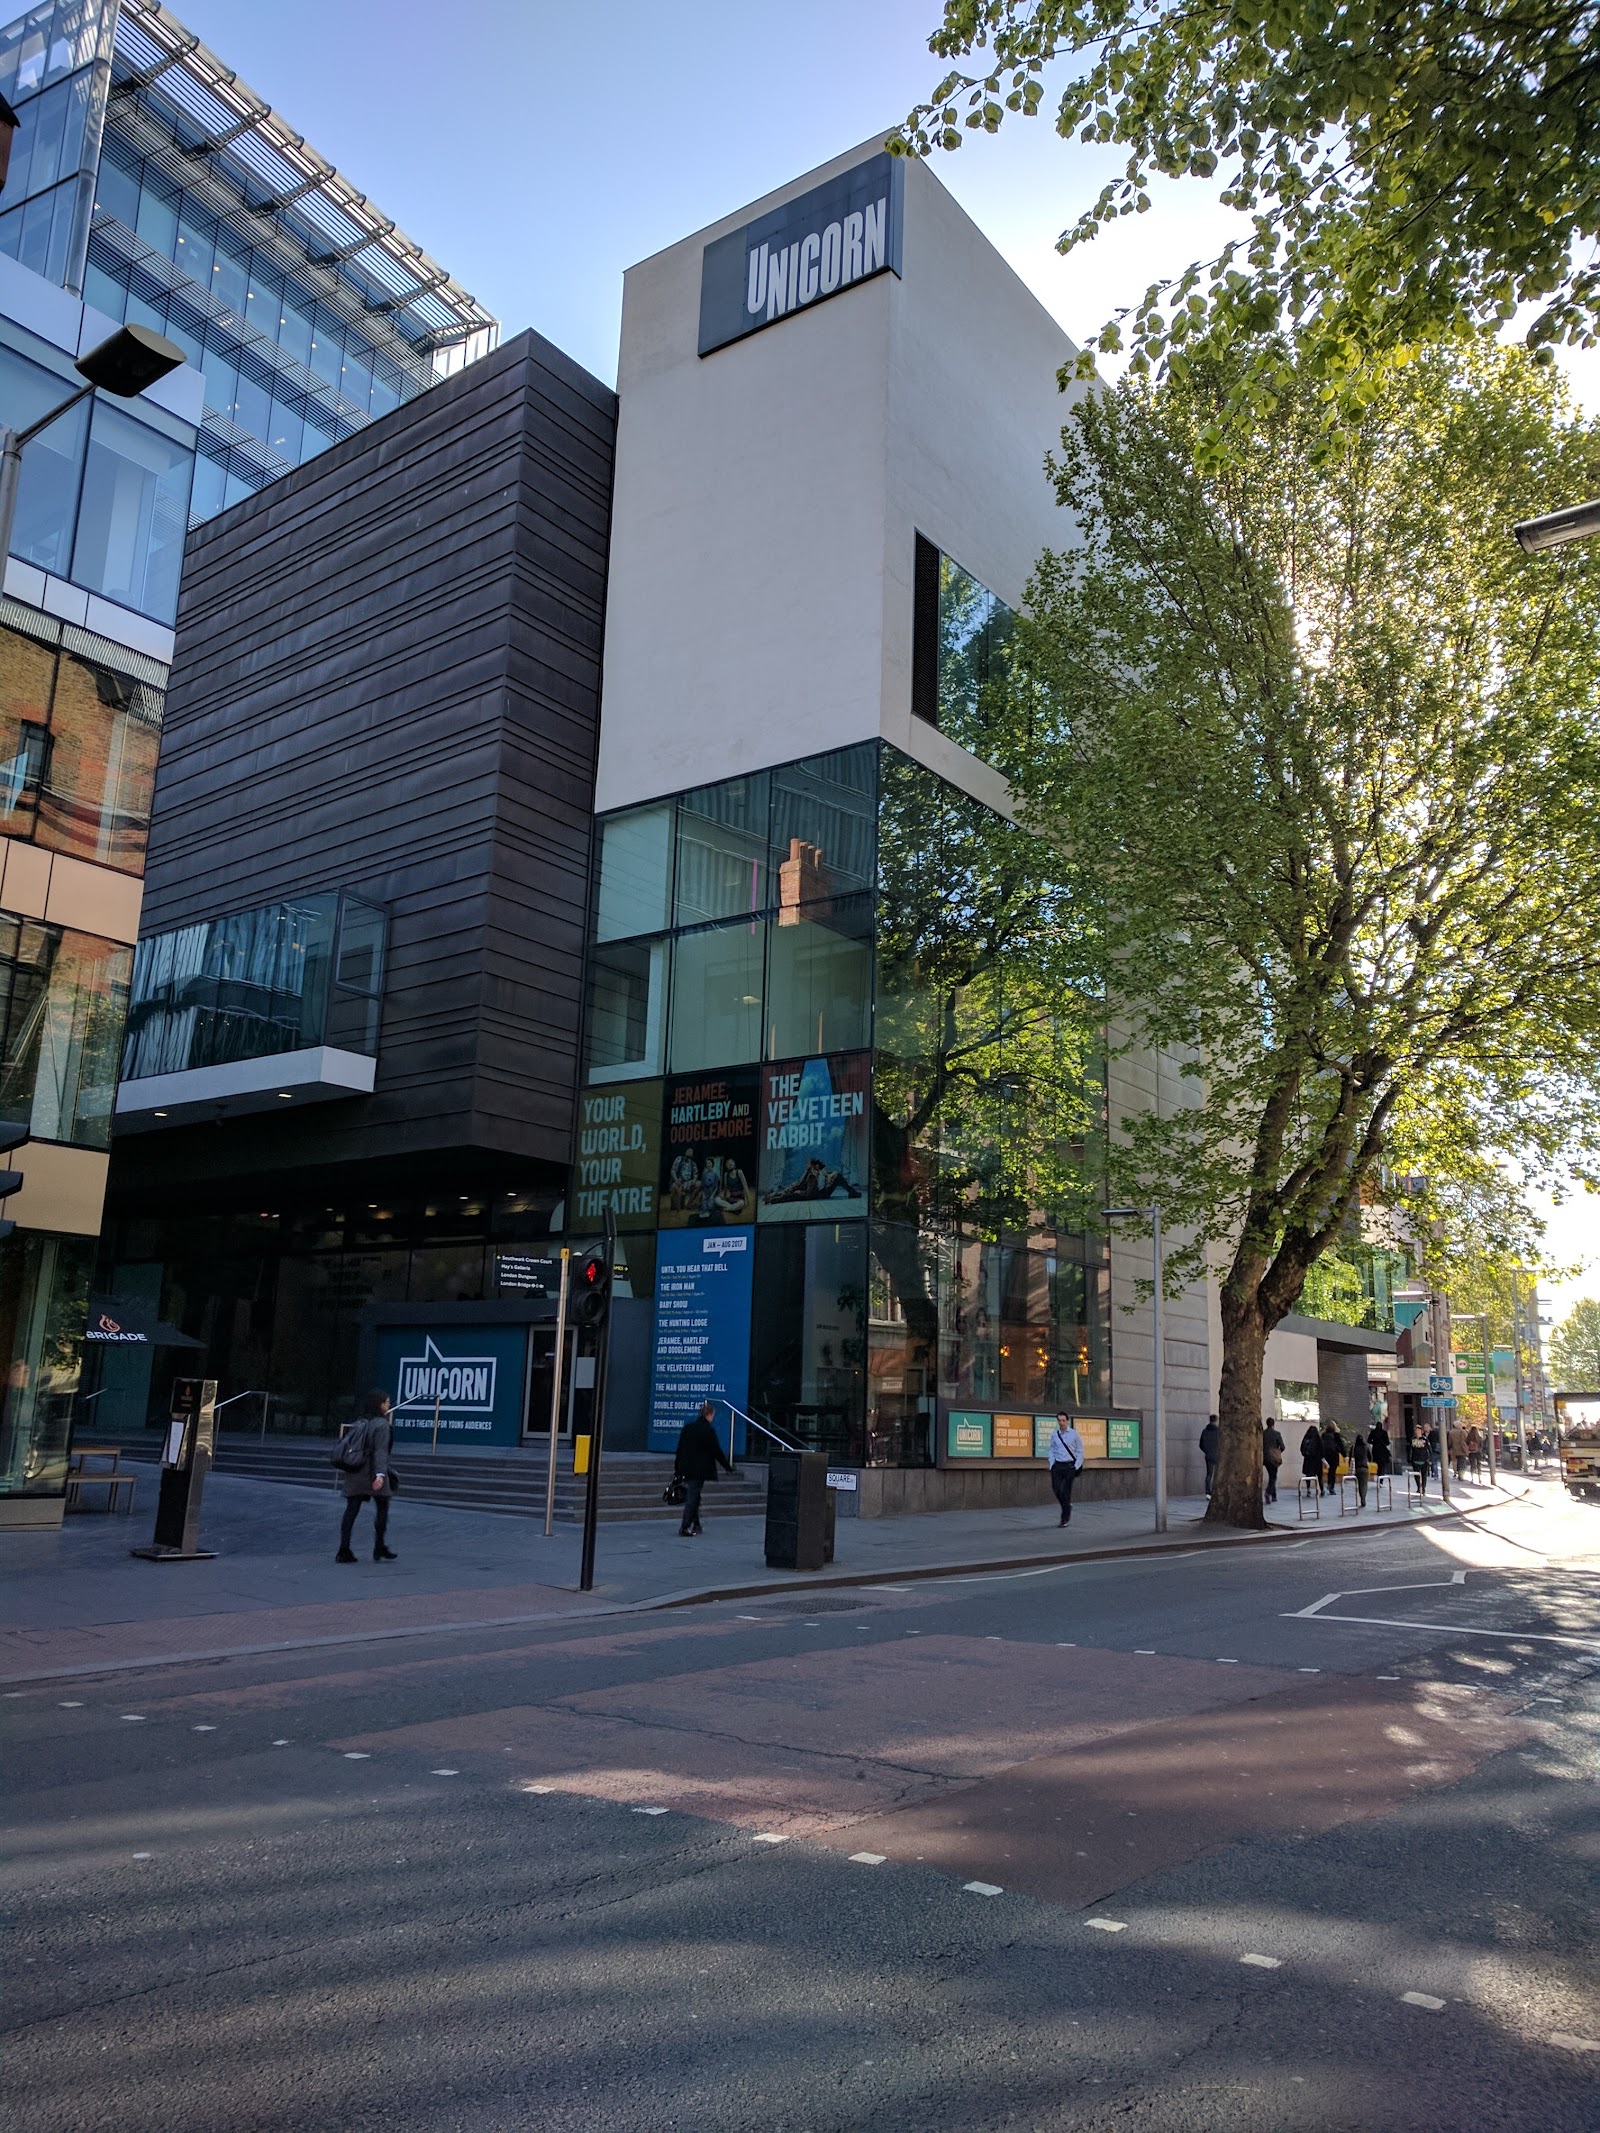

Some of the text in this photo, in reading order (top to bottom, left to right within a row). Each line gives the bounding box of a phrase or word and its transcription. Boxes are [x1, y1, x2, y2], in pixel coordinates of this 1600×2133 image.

[747, 197, 887, 321] UNICORN
[768, 1073, 801, 1099] THE
[673, 1082, 729, 1105] JERAMEE,
[584, 1095, 626, 1124] YOUR
[670, 1101, 750, 1125] HARTLEBY AND
[767, 1091, 864, 1124] VELVETEEN
[670, 1117, 753, 1144] OOOGLEMORE
[581, 1124, 647, 1154] WORLD,
[766, 1122, 826, 1151] RABBIT
[579, 1158, 622, 1186] YOUR
[577, 1186, 653, 1217] THEATRE
[707, 1241, 717, 1249] JAN
[722, 1240, 731, 1248] AUG
[731, 1240, 743, 1248] 2017
[501, 1263, 514, 1271] Hay's
[661, 1263, 728, 1274] UNTIL YOU HEAR THAT BELL
[517, 1281, 531, 1289] Bridge
[661, 1282, 695, 1291] THE IRON MAN
[659, 1300, 688, 1309] BABY SHOW
[659, 1318, 708, 1327] THE HUNTING LODGE
[86, 1331, 148, 1341] BRIGADE
[658, 1336, 709, 1346] JERAMEE, HARTLEBY
[657, 1346, 668, 1354] AND
[656, 1363, 715, 1372] THE VELVETEEN RABBIT
[404, 1367, 488, 1401] UNICORN
[655, 1383, 726, 1392] THE MAN WHO KNOWS IT ALL
[654, 1401, 674, 1410] DOUBLE
[674, 1401, 695, 1410] DOUBLE
[395, 1418, 404, 1426] THE
[416, 1419, 436, 1428] THEATR
[438, 1420, 448, 1428] FOR
[448, 1420, 464, 1429] YOUNG
[465, 1421, 492, 1430] AUDIENCES
[828, 1474, 850, 1482] SQUARE
